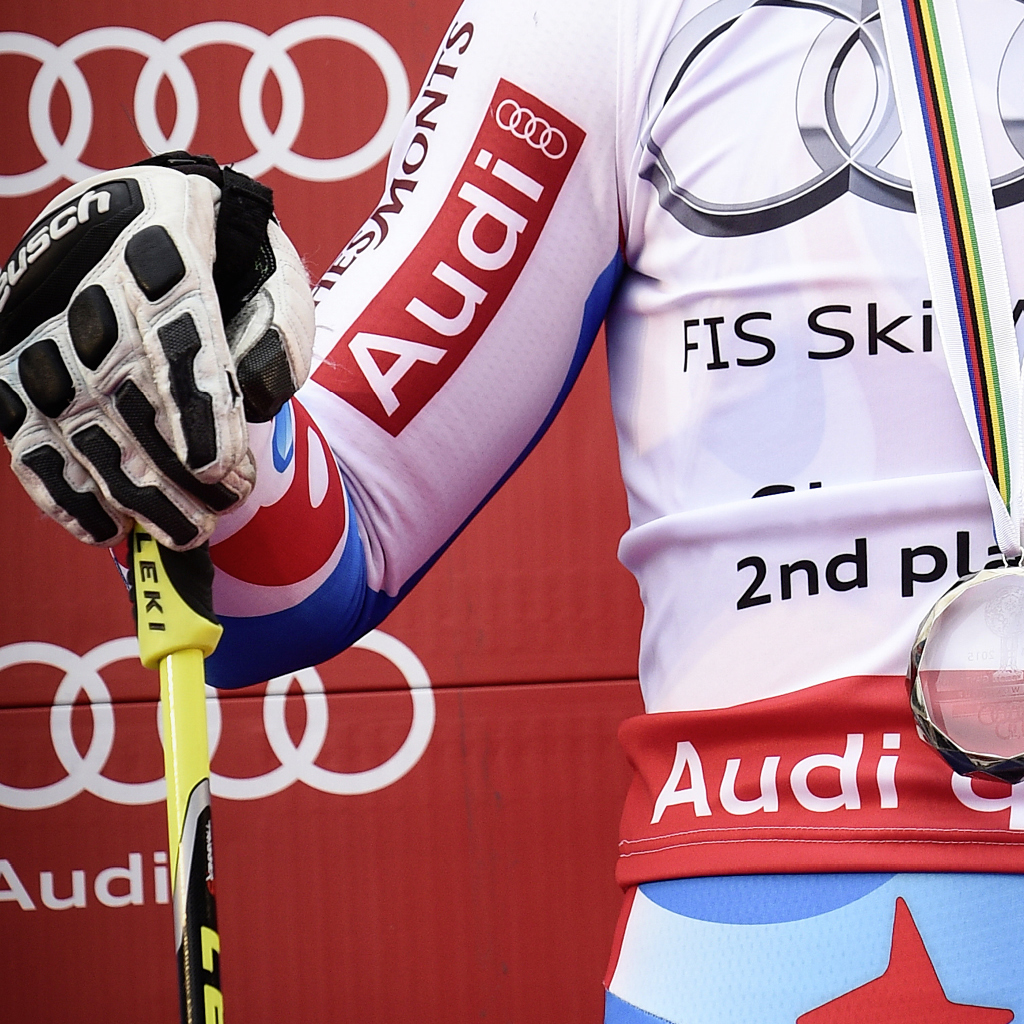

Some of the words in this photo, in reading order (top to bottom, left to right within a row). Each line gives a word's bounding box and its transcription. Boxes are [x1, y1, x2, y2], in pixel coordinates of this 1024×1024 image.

[348, 148, 544, 417] Audi
[683, 312, 775, 372] FIS
[807, 299, 932, 360] Ski
[135, 532, 166, 631] LEKI
[736, 537, 867, 610] 2nd
[651, 733, 900, 824] Audi
